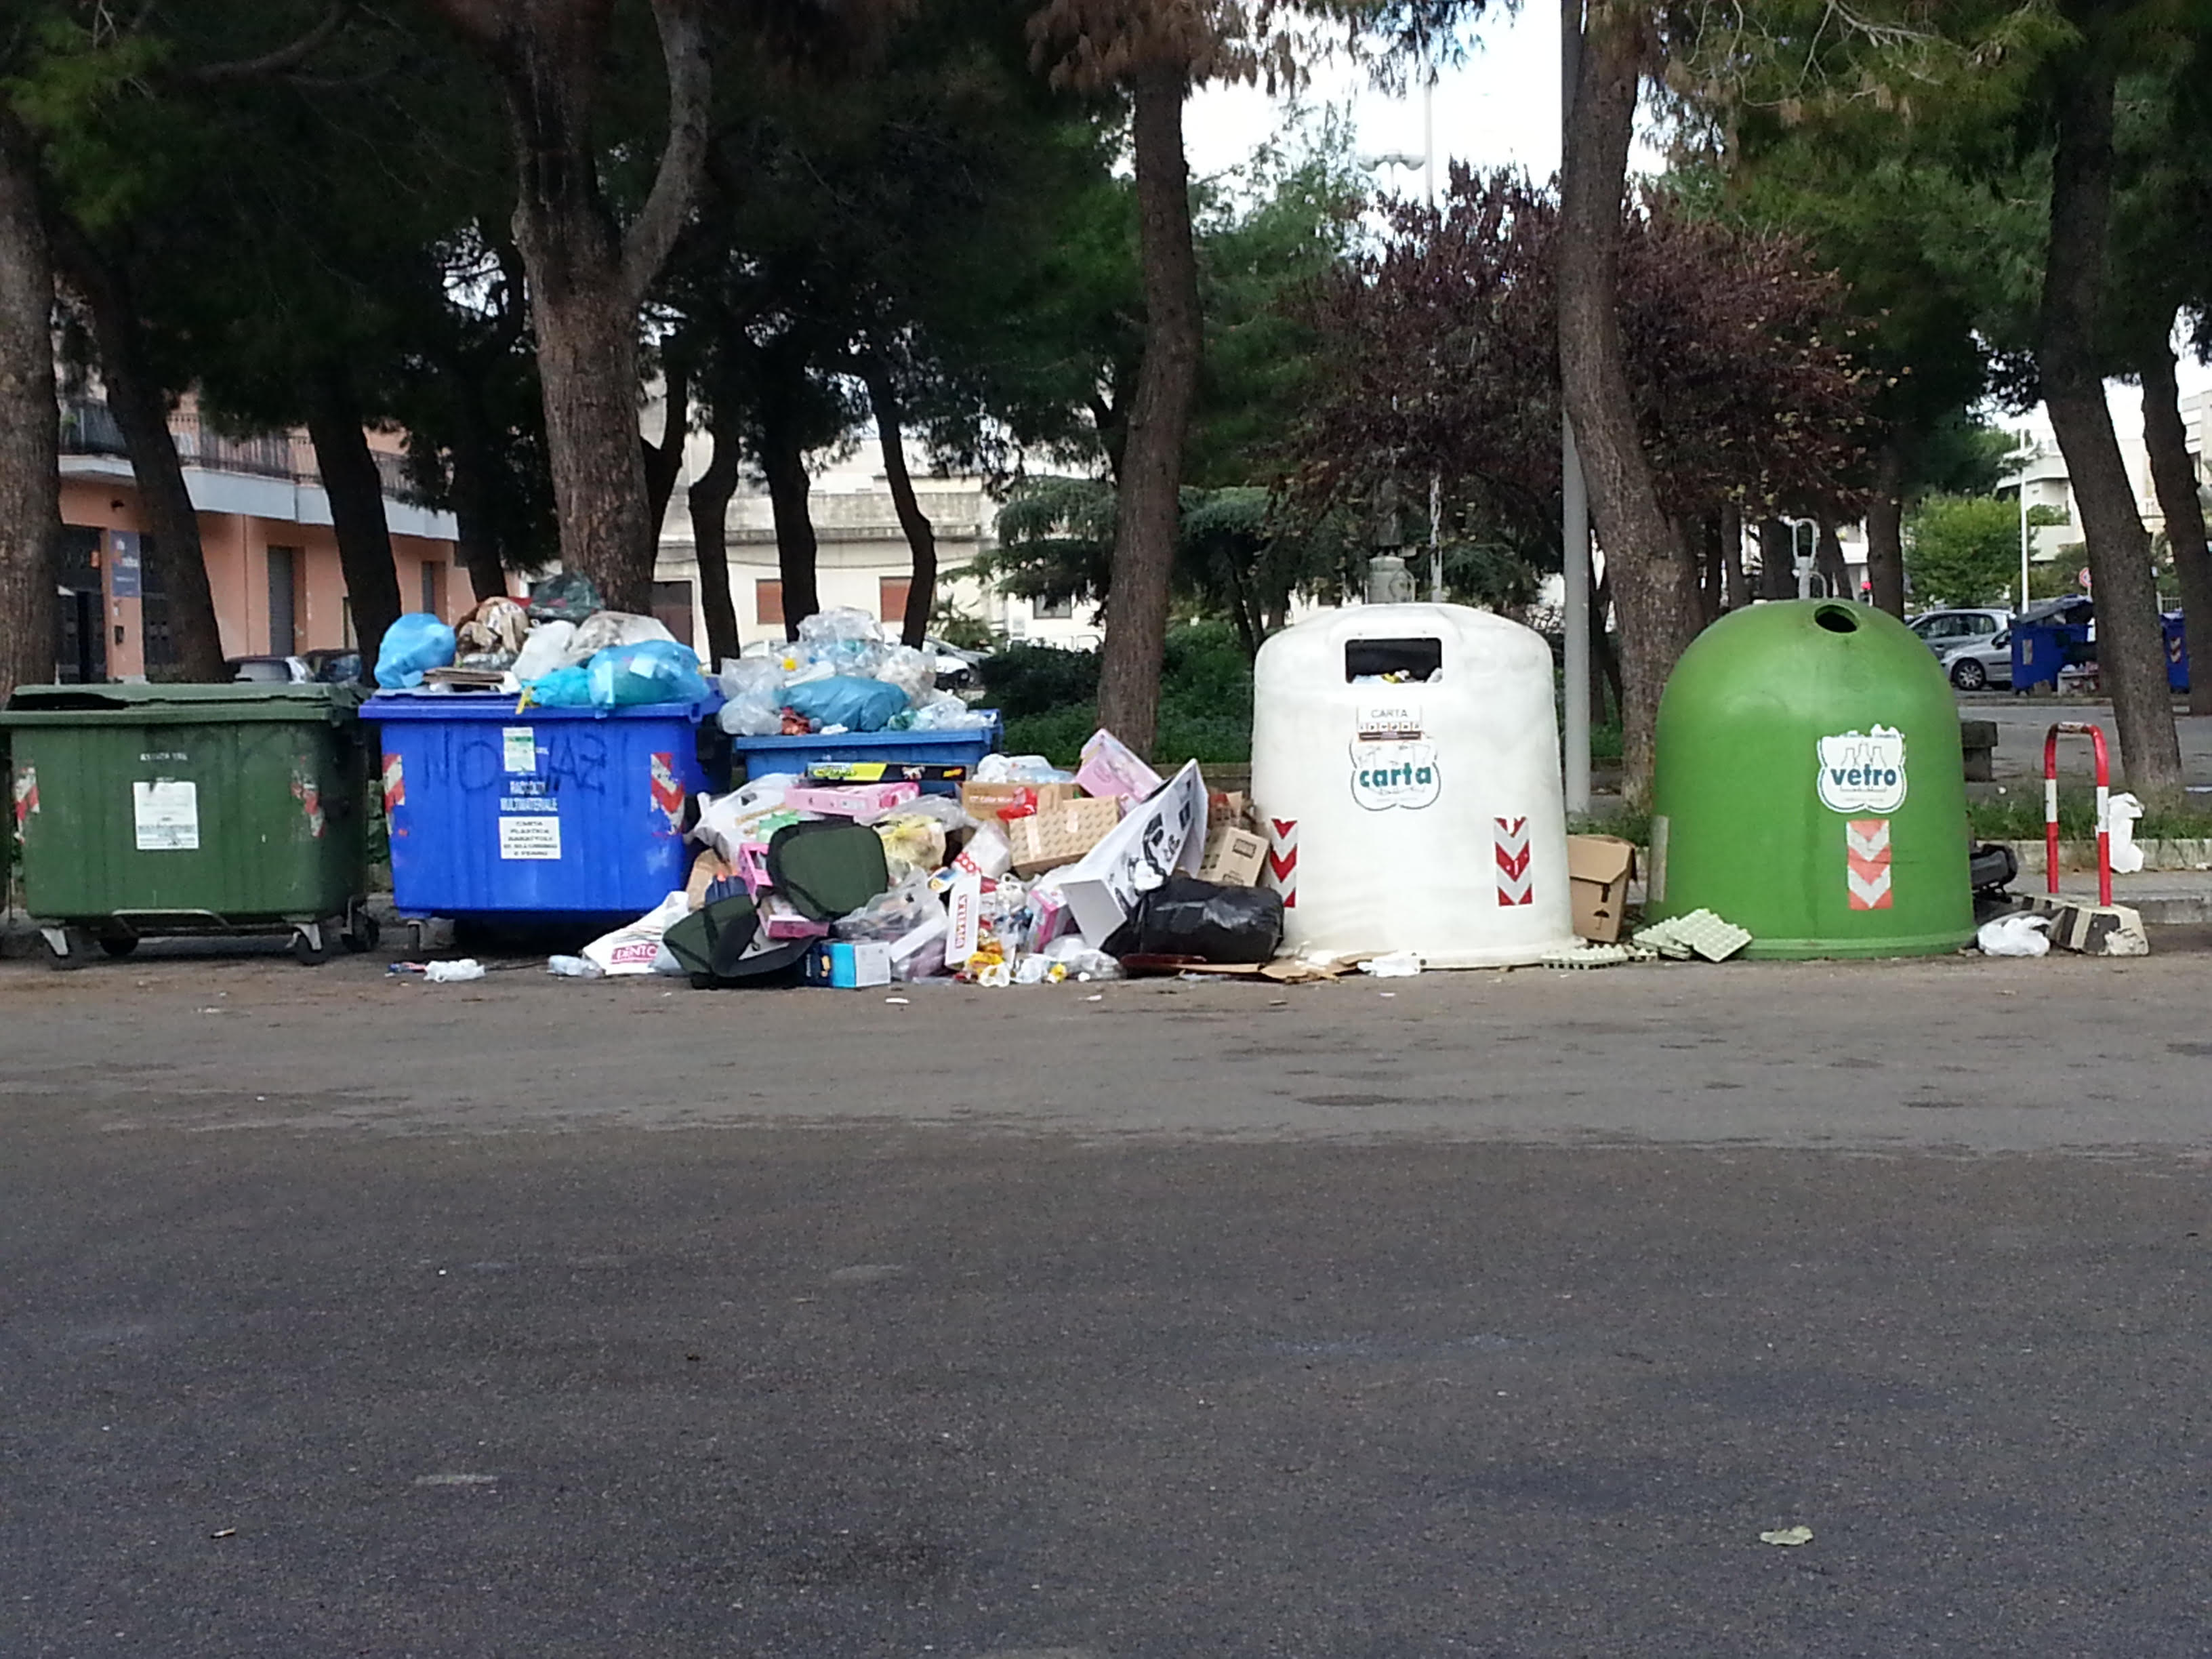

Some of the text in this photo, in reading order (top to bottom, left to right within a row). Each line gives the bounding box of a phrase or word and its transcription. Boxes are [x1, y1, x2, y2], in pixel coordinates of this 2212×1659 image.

[1370, 709, 1408, 718] CARTA
[1359, 762, 1431, 787] carta
[1830, 764, 1896, 786] vetro
